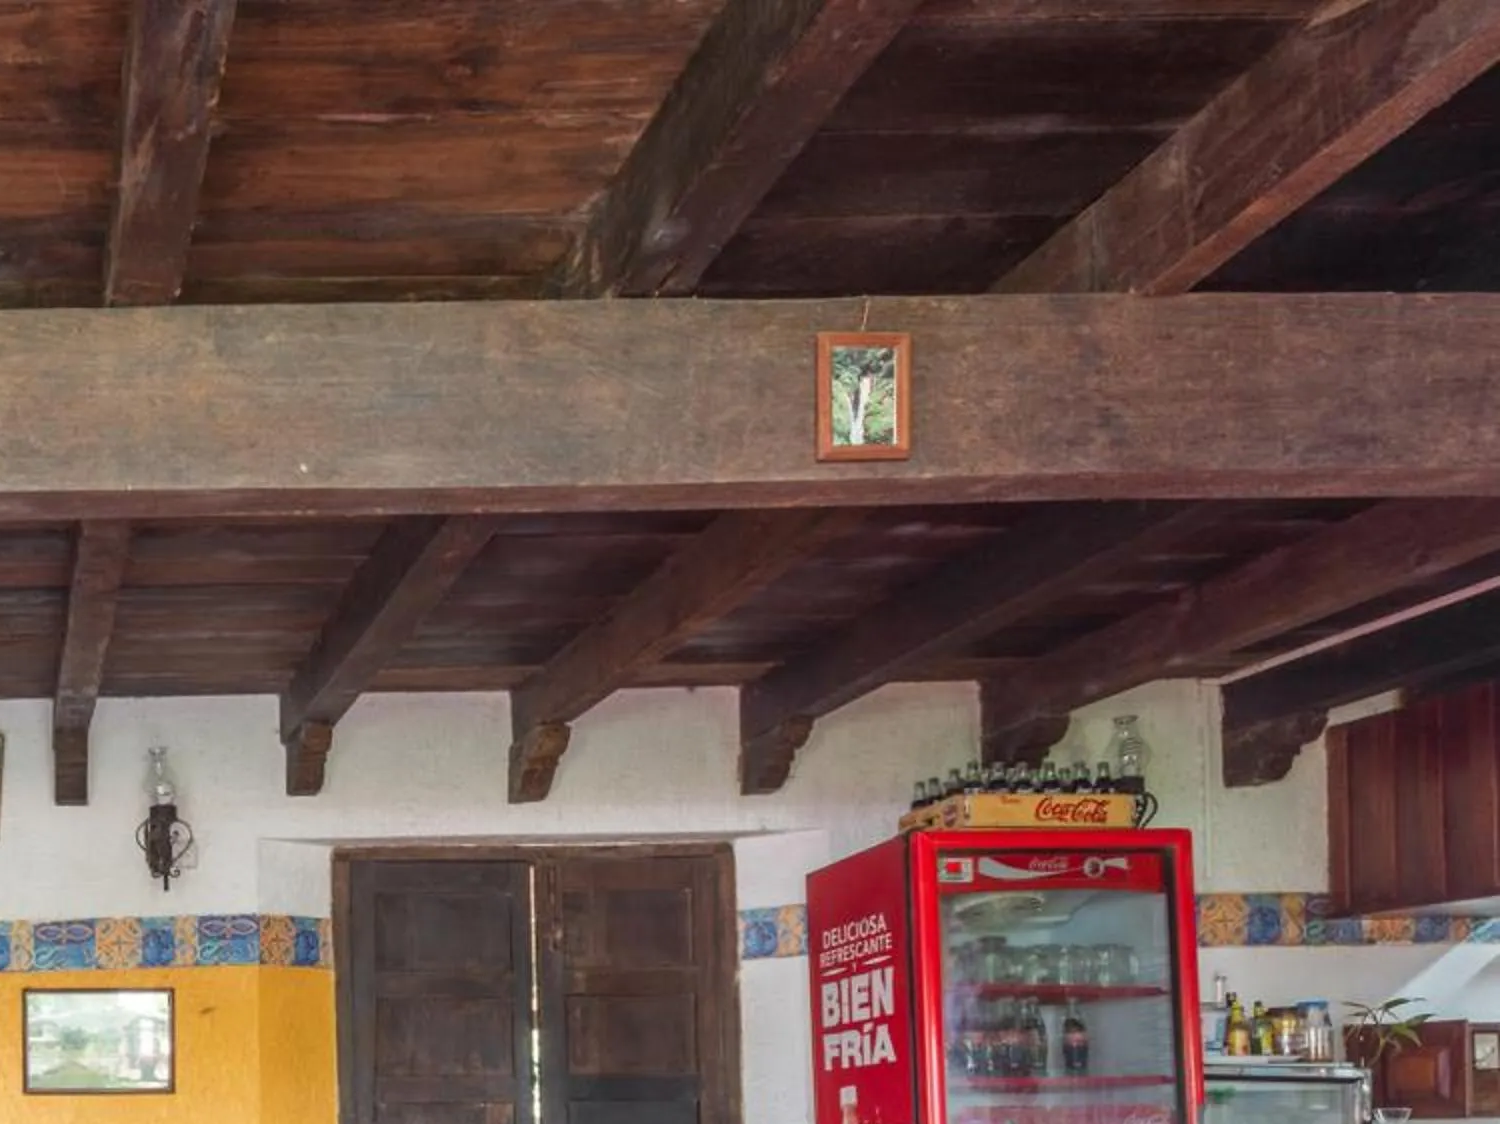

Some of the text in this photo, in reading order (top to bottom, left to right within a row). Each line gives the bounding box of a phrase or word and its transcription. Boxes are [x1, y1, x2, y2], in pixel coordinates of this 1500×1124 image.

[819, 932, 893, 968] REFRESCANTE
[822, 913, 887, 948] DELICIOSA
[821, 965, 895, 1029] BIEN
[823, 1022, 897, 1072] FRÍA
